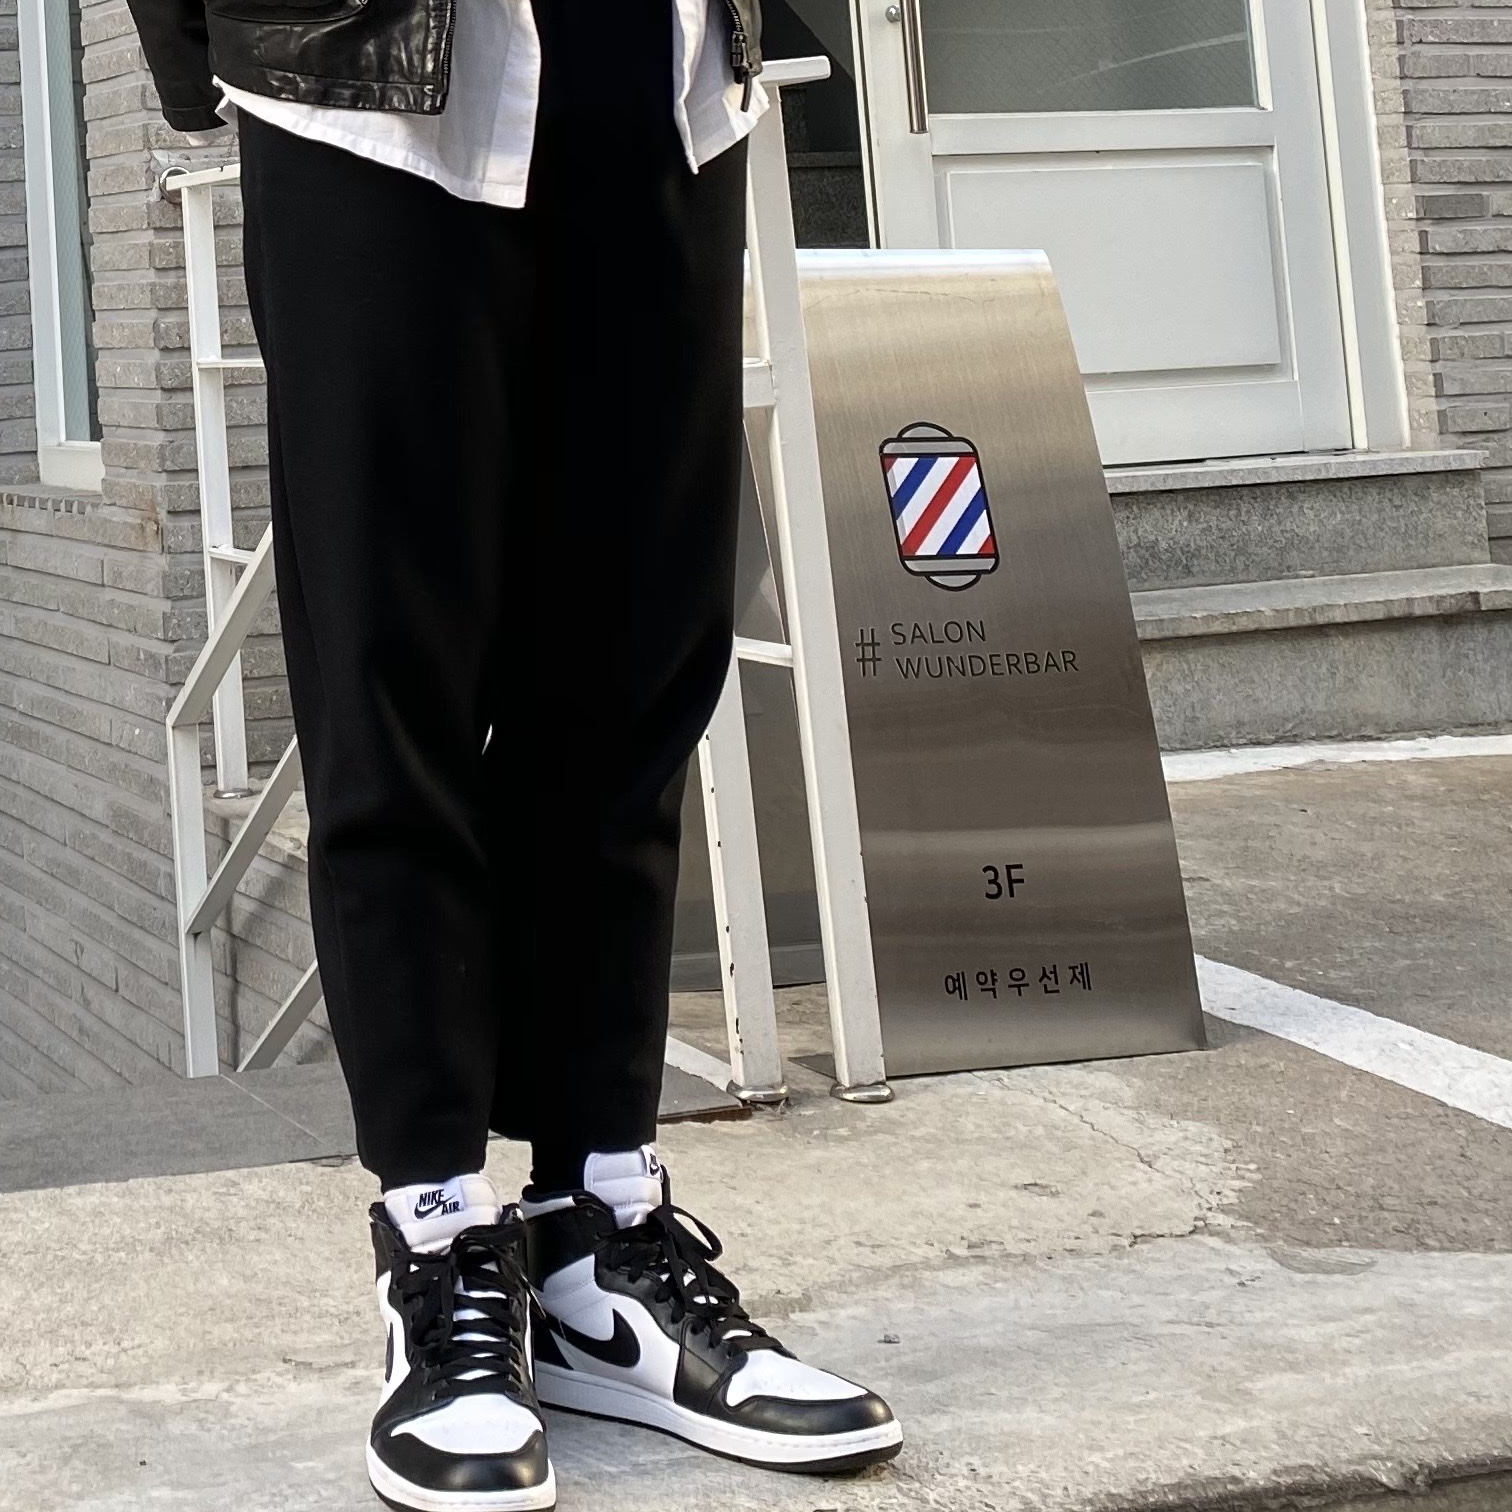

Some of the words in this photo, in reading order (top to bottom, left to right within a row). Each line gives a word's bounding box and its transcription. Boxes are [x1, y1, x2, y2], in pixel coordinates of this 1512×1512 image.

[890, 618, 987, 646] SALON
[895, 649, 1080, 681] WUNDERBAR
[981, 862, 1026, 901] 3F
[419, 1188, 445, 1208] NIKE
[441, 1201, 461, 1216] AIR
